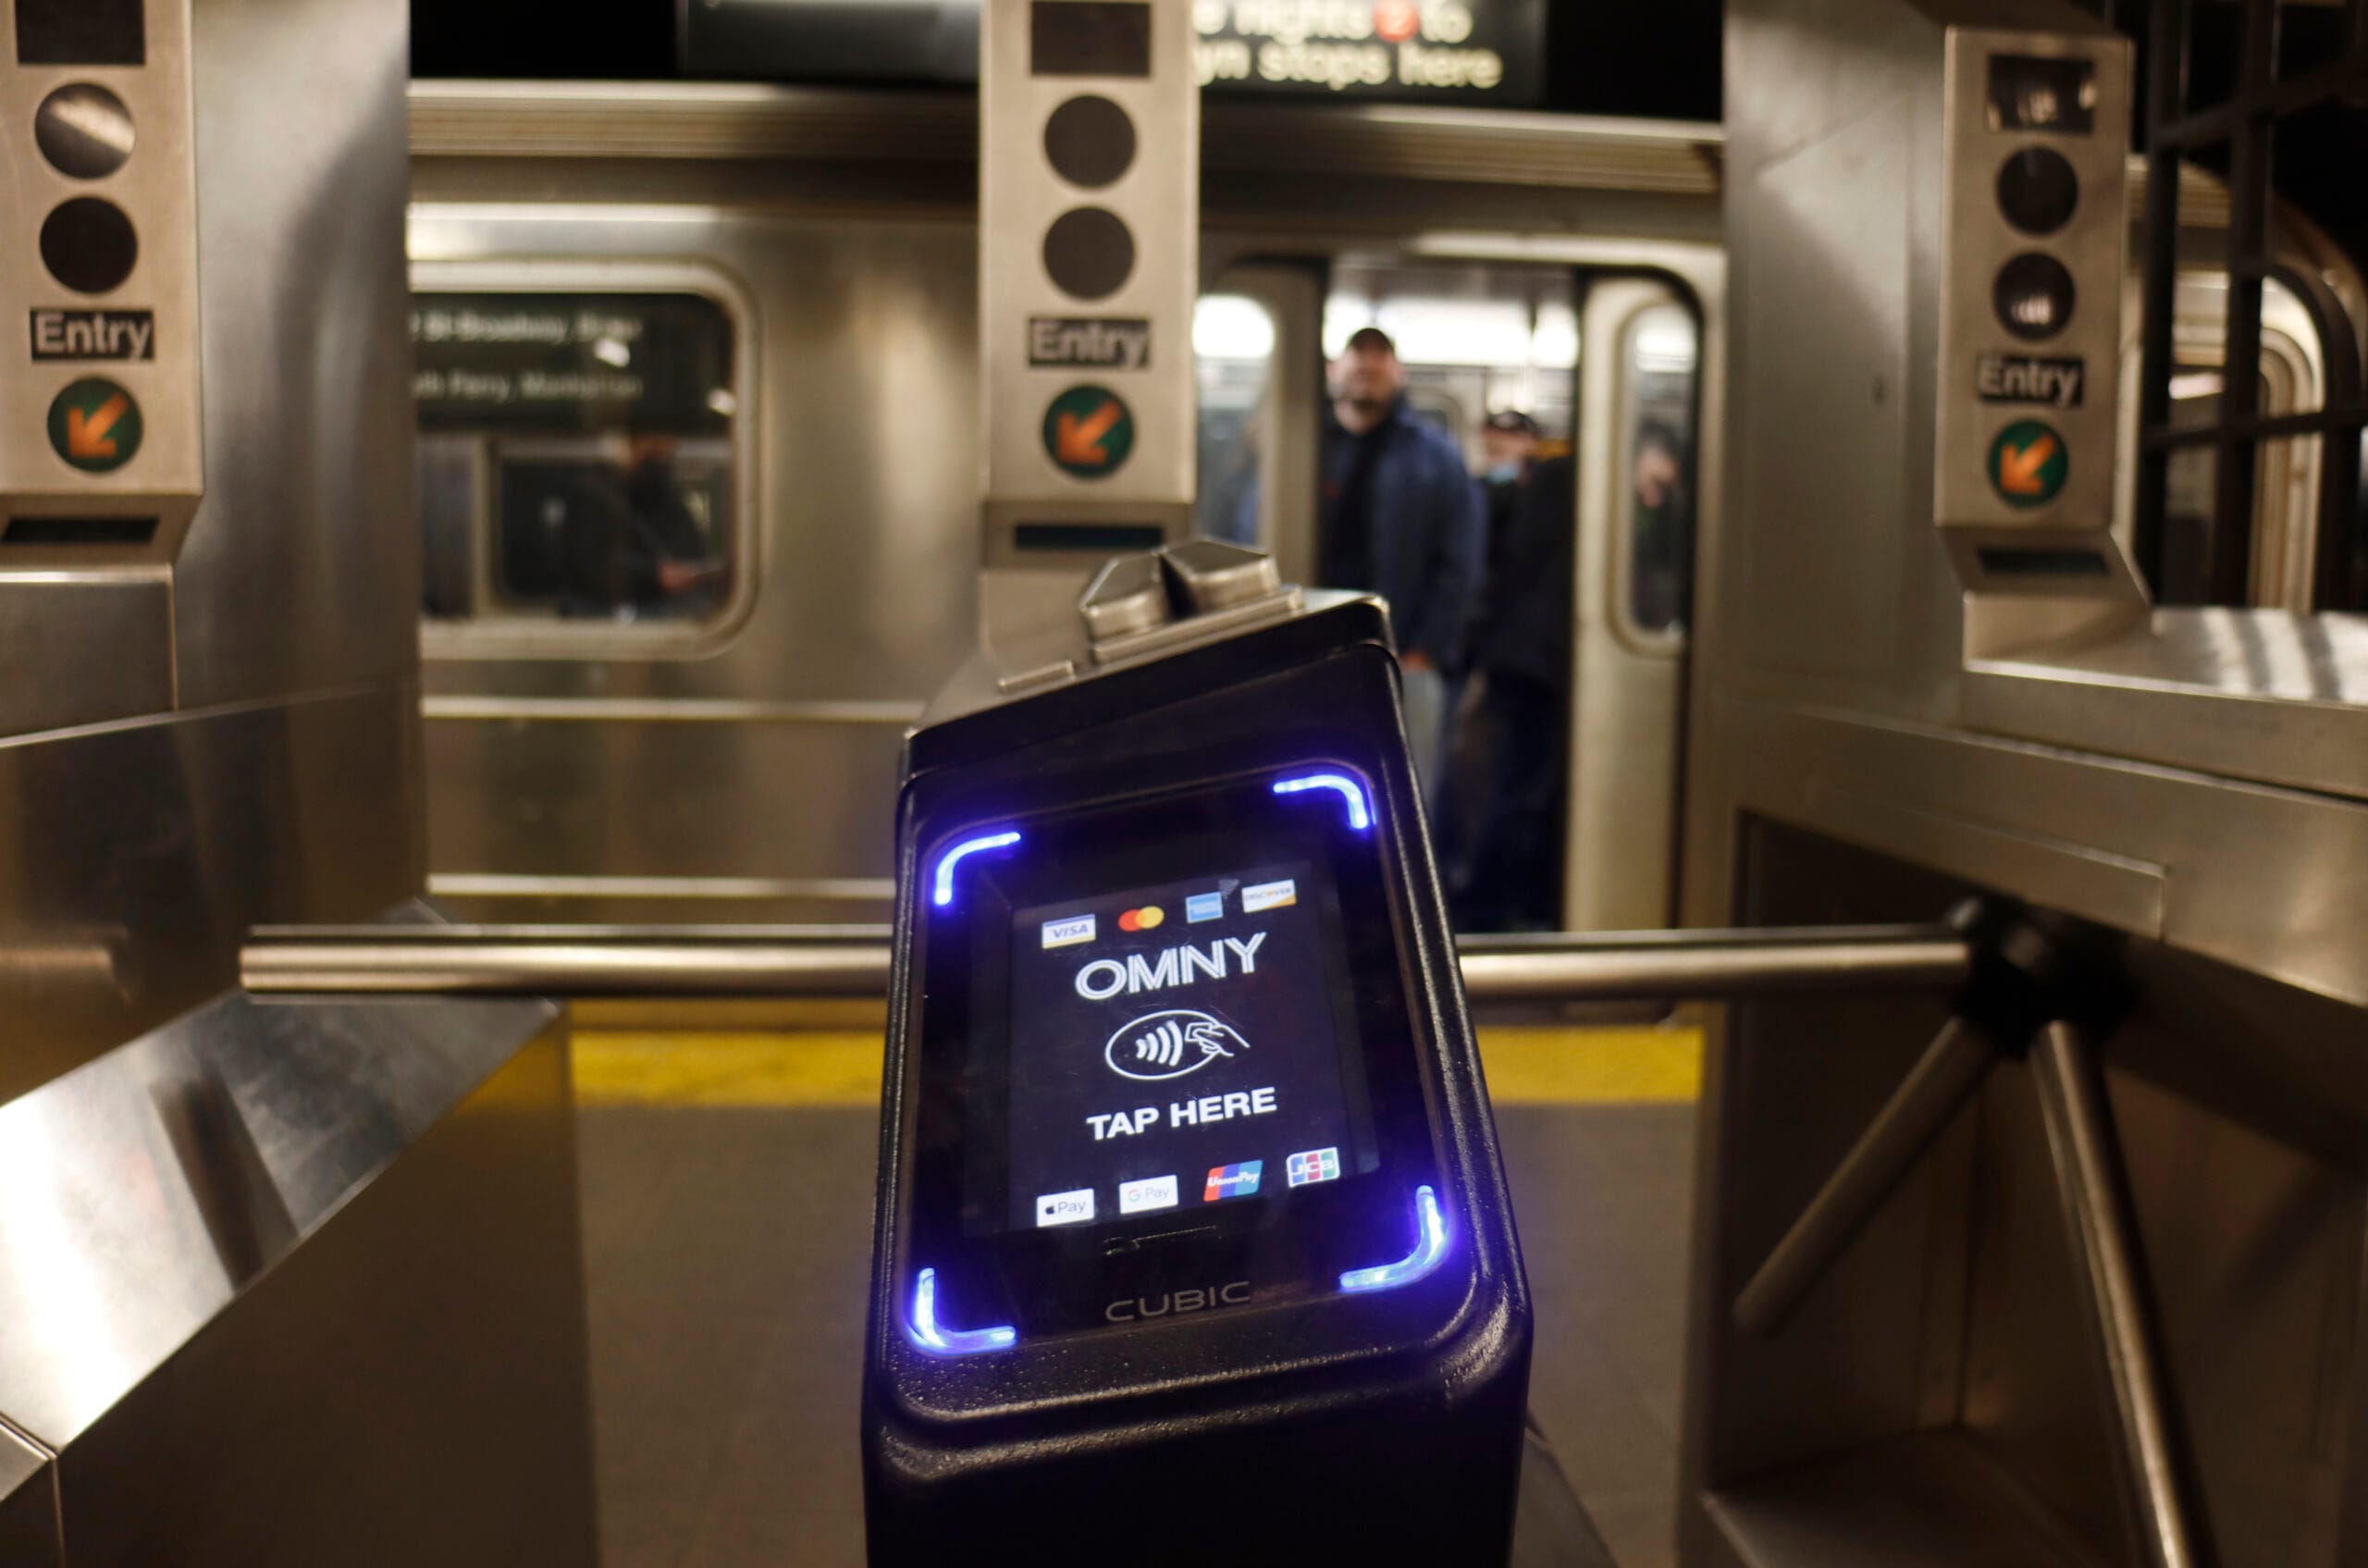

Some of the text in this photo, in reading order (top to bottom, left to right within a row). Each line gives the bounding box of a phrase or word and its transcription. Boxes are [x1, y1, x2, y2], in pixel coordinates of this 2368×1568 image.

[1420, 0, 1473, 43] to
[1258, 42, 1390, 90] stops
[1398, 43, 1504, 89] here
[35, 312, 151, 358] Entry
[1031, 319, 1149, 368] Entry
[1979, 357, 2080, 407] Entry
[1053, 924, 1089, 938] VISA
[1074, 932, 1267, 1000] OMNY
[1086, 1086, 1277, 1141] TAP HERE
[1206, 1171, 1260, 1189] UnionPay
[1290, 1159, 1334, 1176] JCB
[1057, 1201, 1087, 1215] Pay
[1145, 1186, 1170, 1200] Pay
[1104, 1280, 1252, 1322] CUBIC
